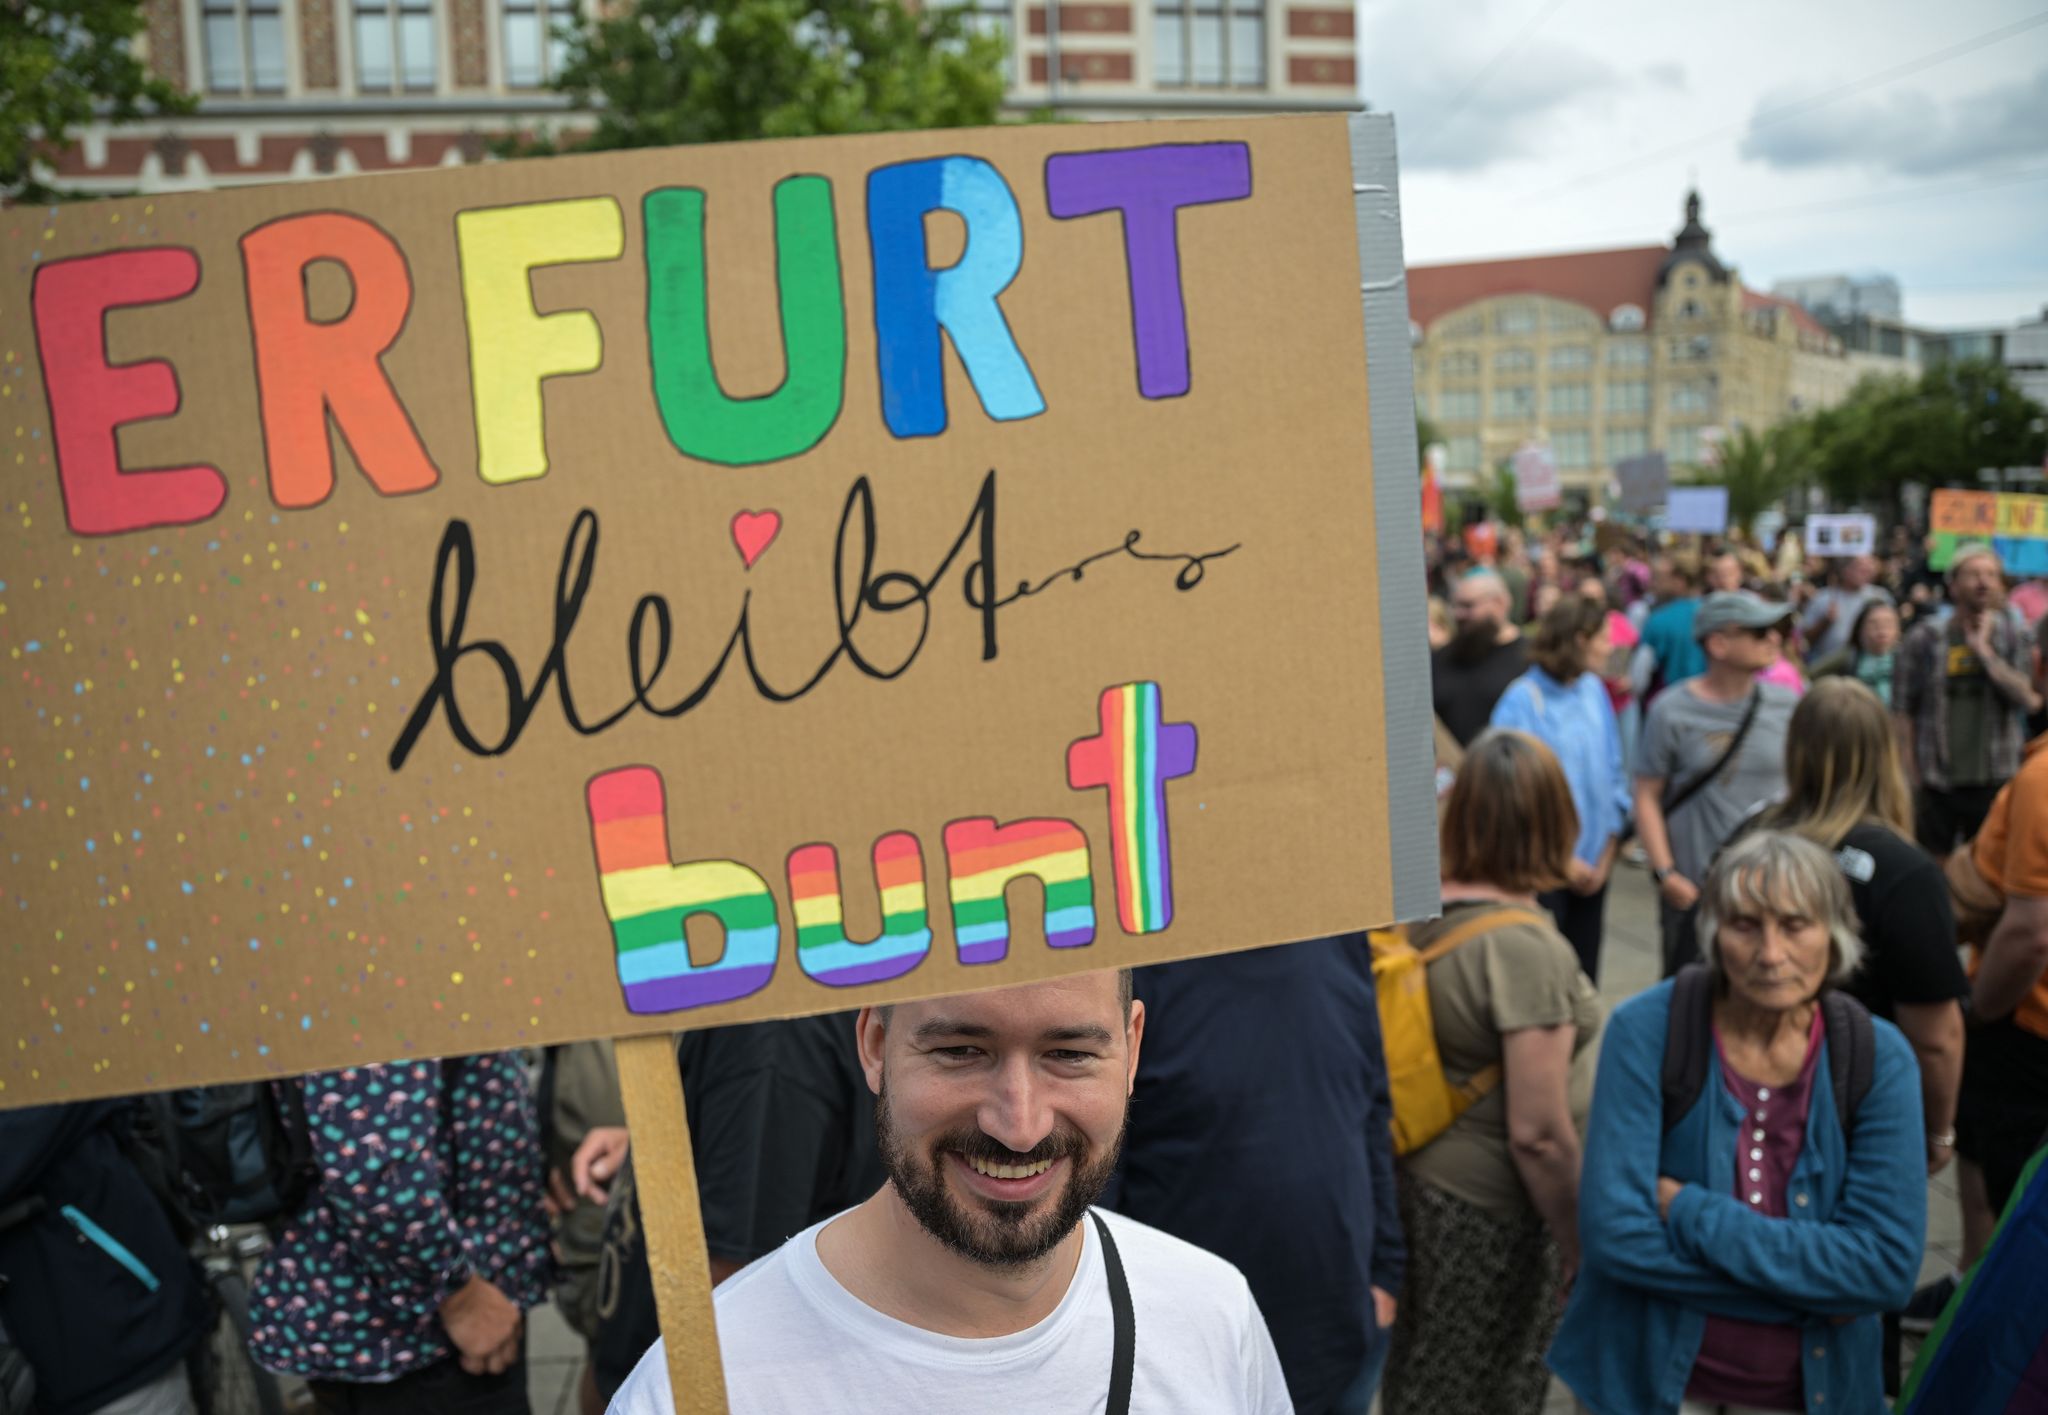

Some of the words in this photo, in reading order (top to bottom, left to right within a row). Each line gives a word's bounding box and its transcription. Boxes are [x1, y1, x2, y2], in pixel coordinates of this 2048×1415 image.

[31, 140, 1252, 537] ERFURT
[389, 468, 1241, 773] bleibt
[586, 681, 1198, 1015] bunt
